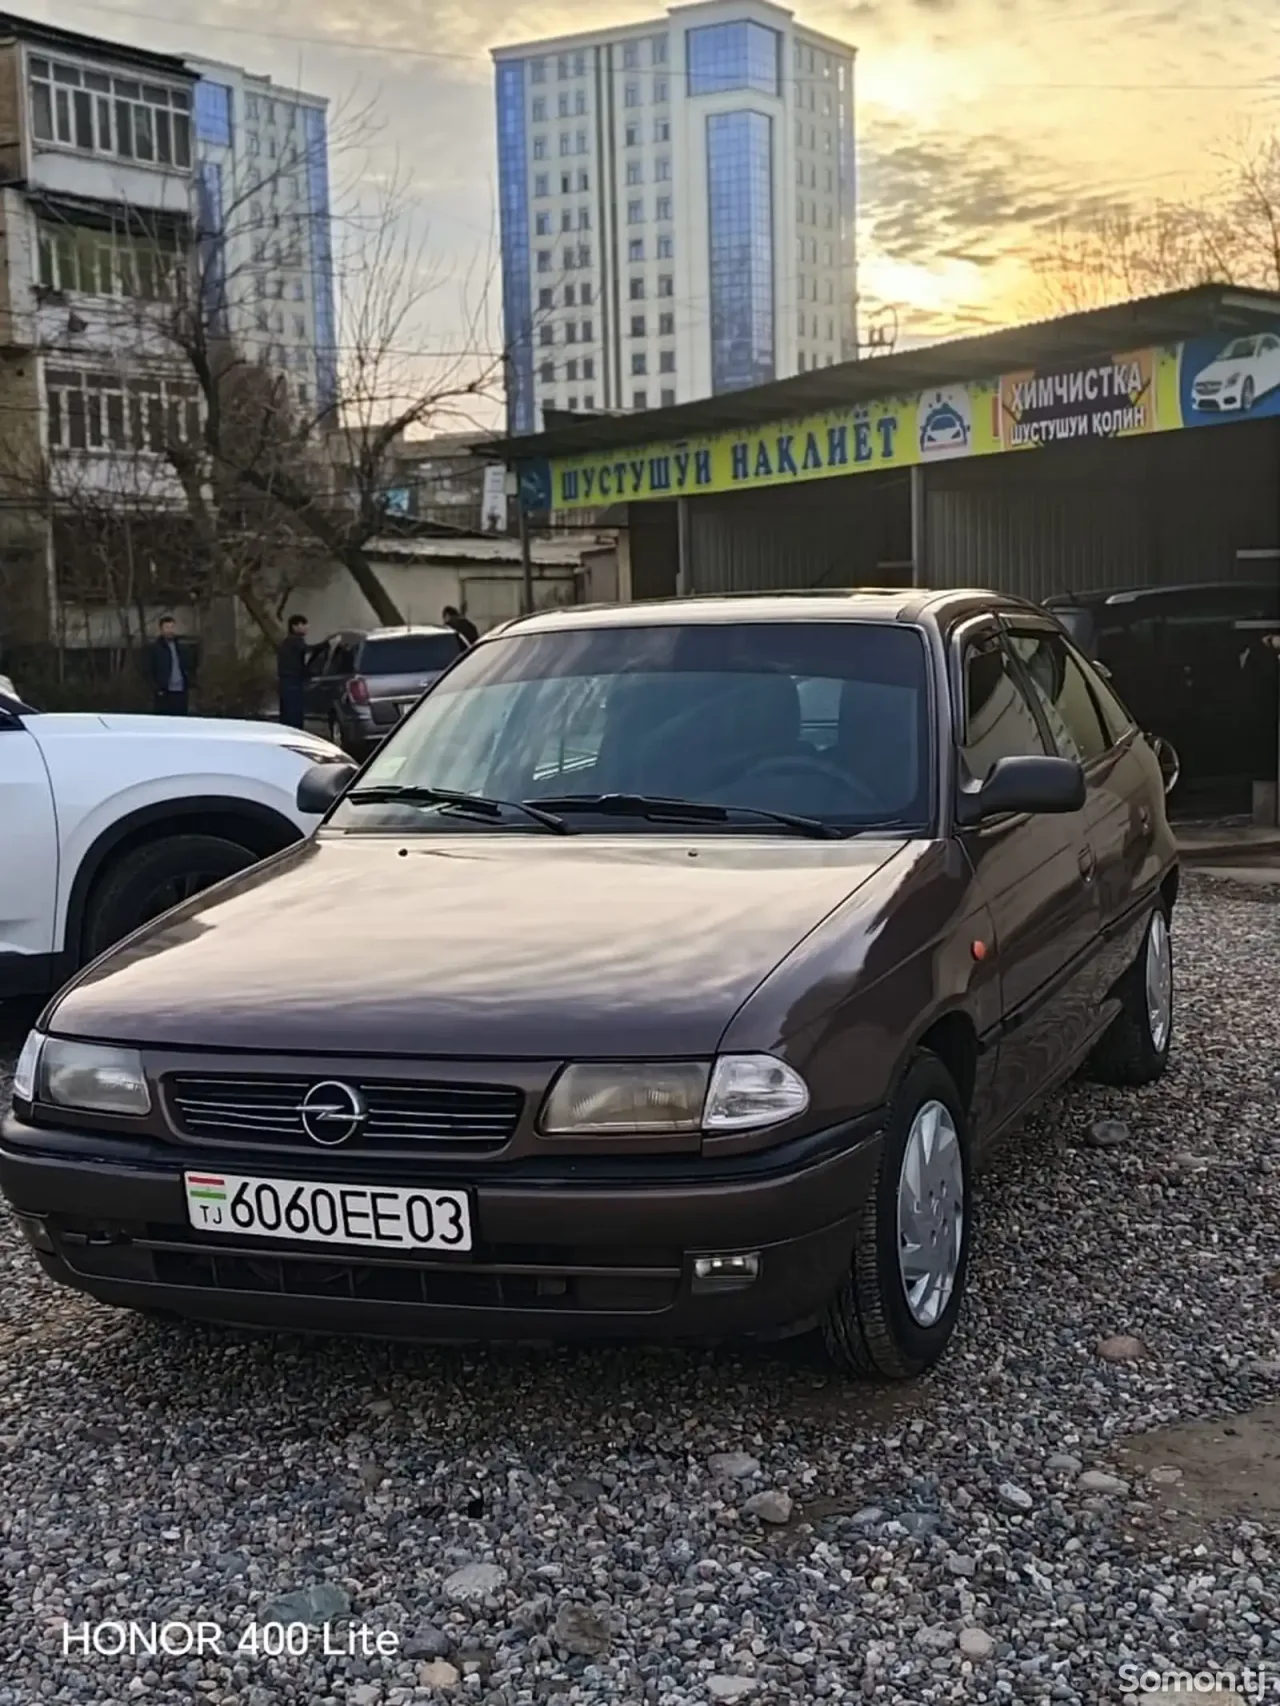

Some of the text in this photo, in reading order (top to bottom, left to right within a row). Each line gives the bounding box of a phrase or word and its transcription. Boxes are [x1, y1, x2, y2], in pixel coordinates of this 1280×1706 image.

[1011, 362, 1142, 412] ХИМЧИСТКА
[199, 1181, 464, 1245] TJ 6060EE03
